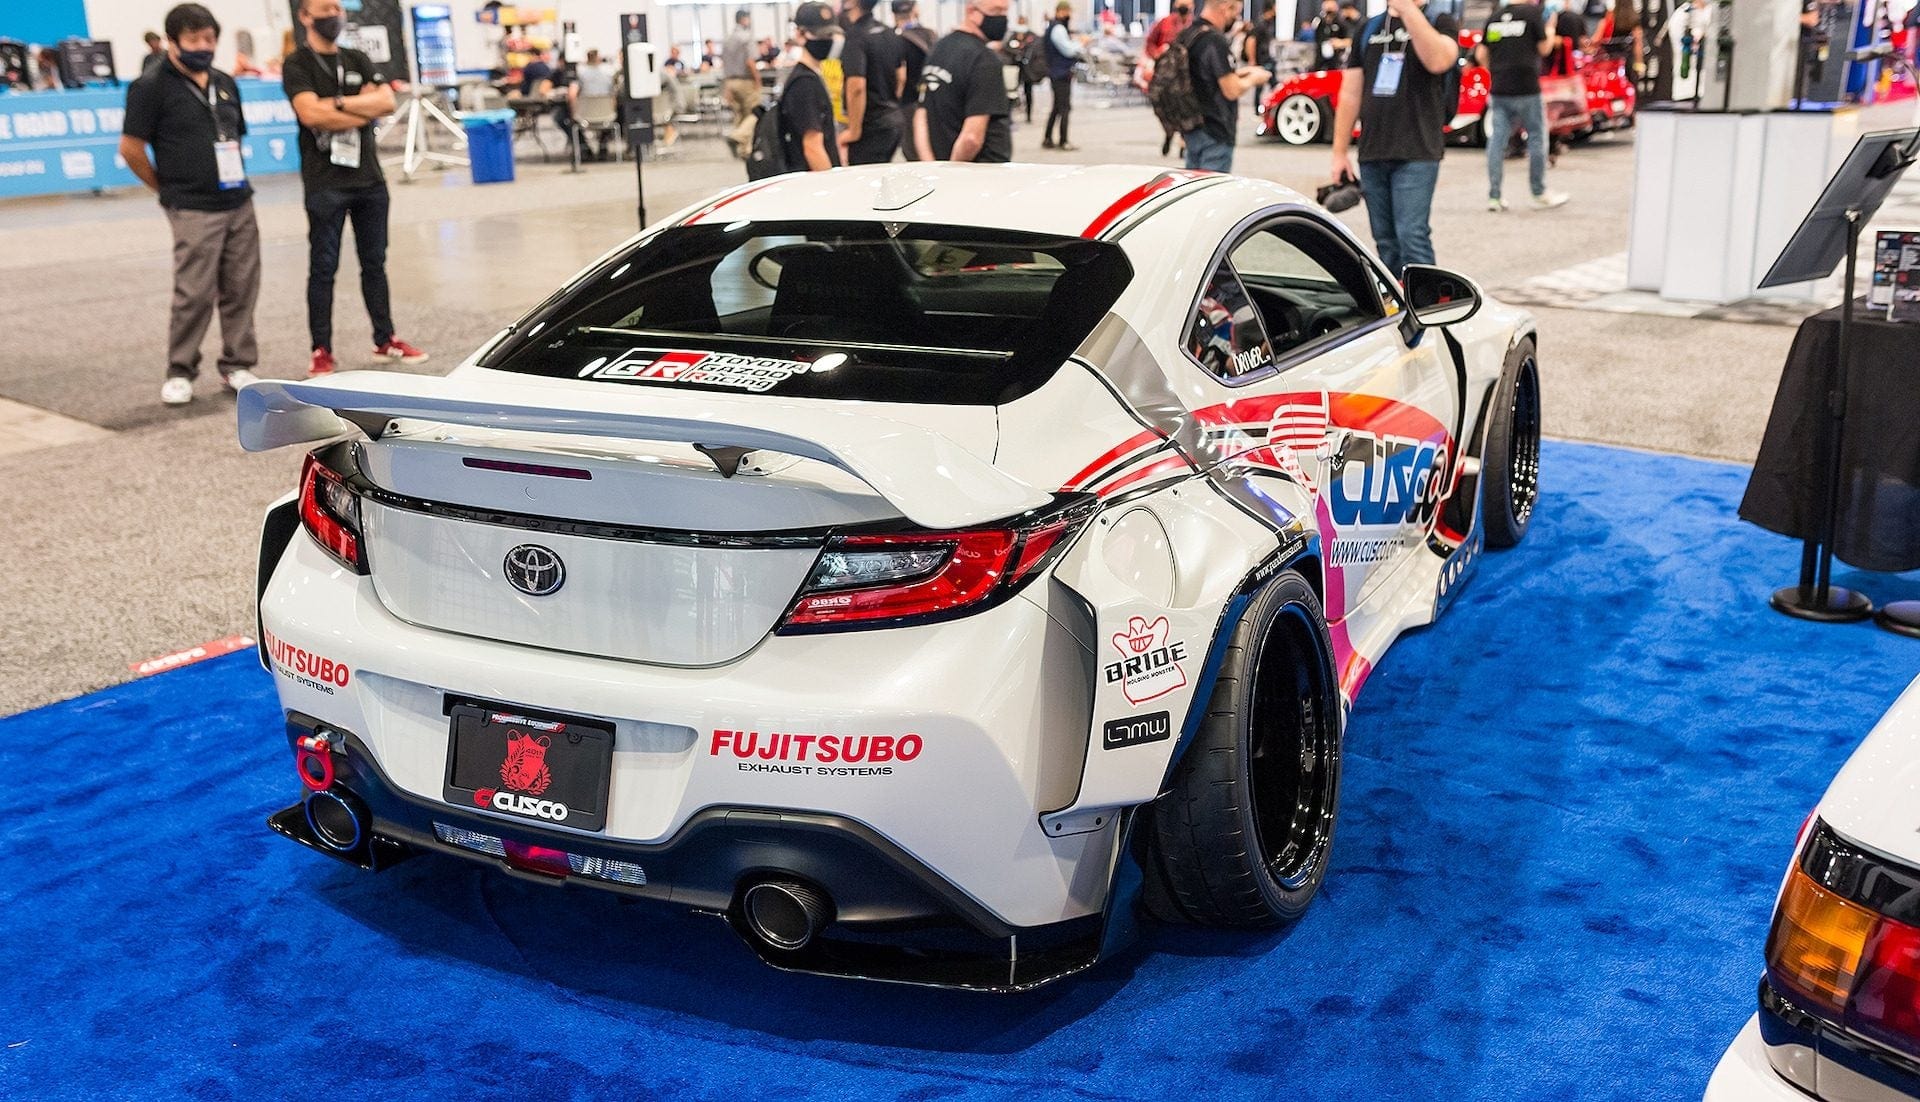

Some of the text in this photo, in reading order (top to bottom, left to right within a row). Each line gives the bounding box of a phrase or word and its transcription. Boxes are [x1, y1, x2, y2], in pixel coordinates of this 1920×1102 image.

[699, 364, 788, 378] GAZOO
[711, 354, 808, 372] TOYOTA
[686, 371, 772, 388] Racing
[1104, 641, 1188, 684] BRIDE
[296, 675, 334, 695] SYSTEMS
[710, 729, 924, 763] FUJITSUBO
[738, 763, 893, 776] EXHAUST SYSTEMS
[493, 791, 568, 821] CUSCO
